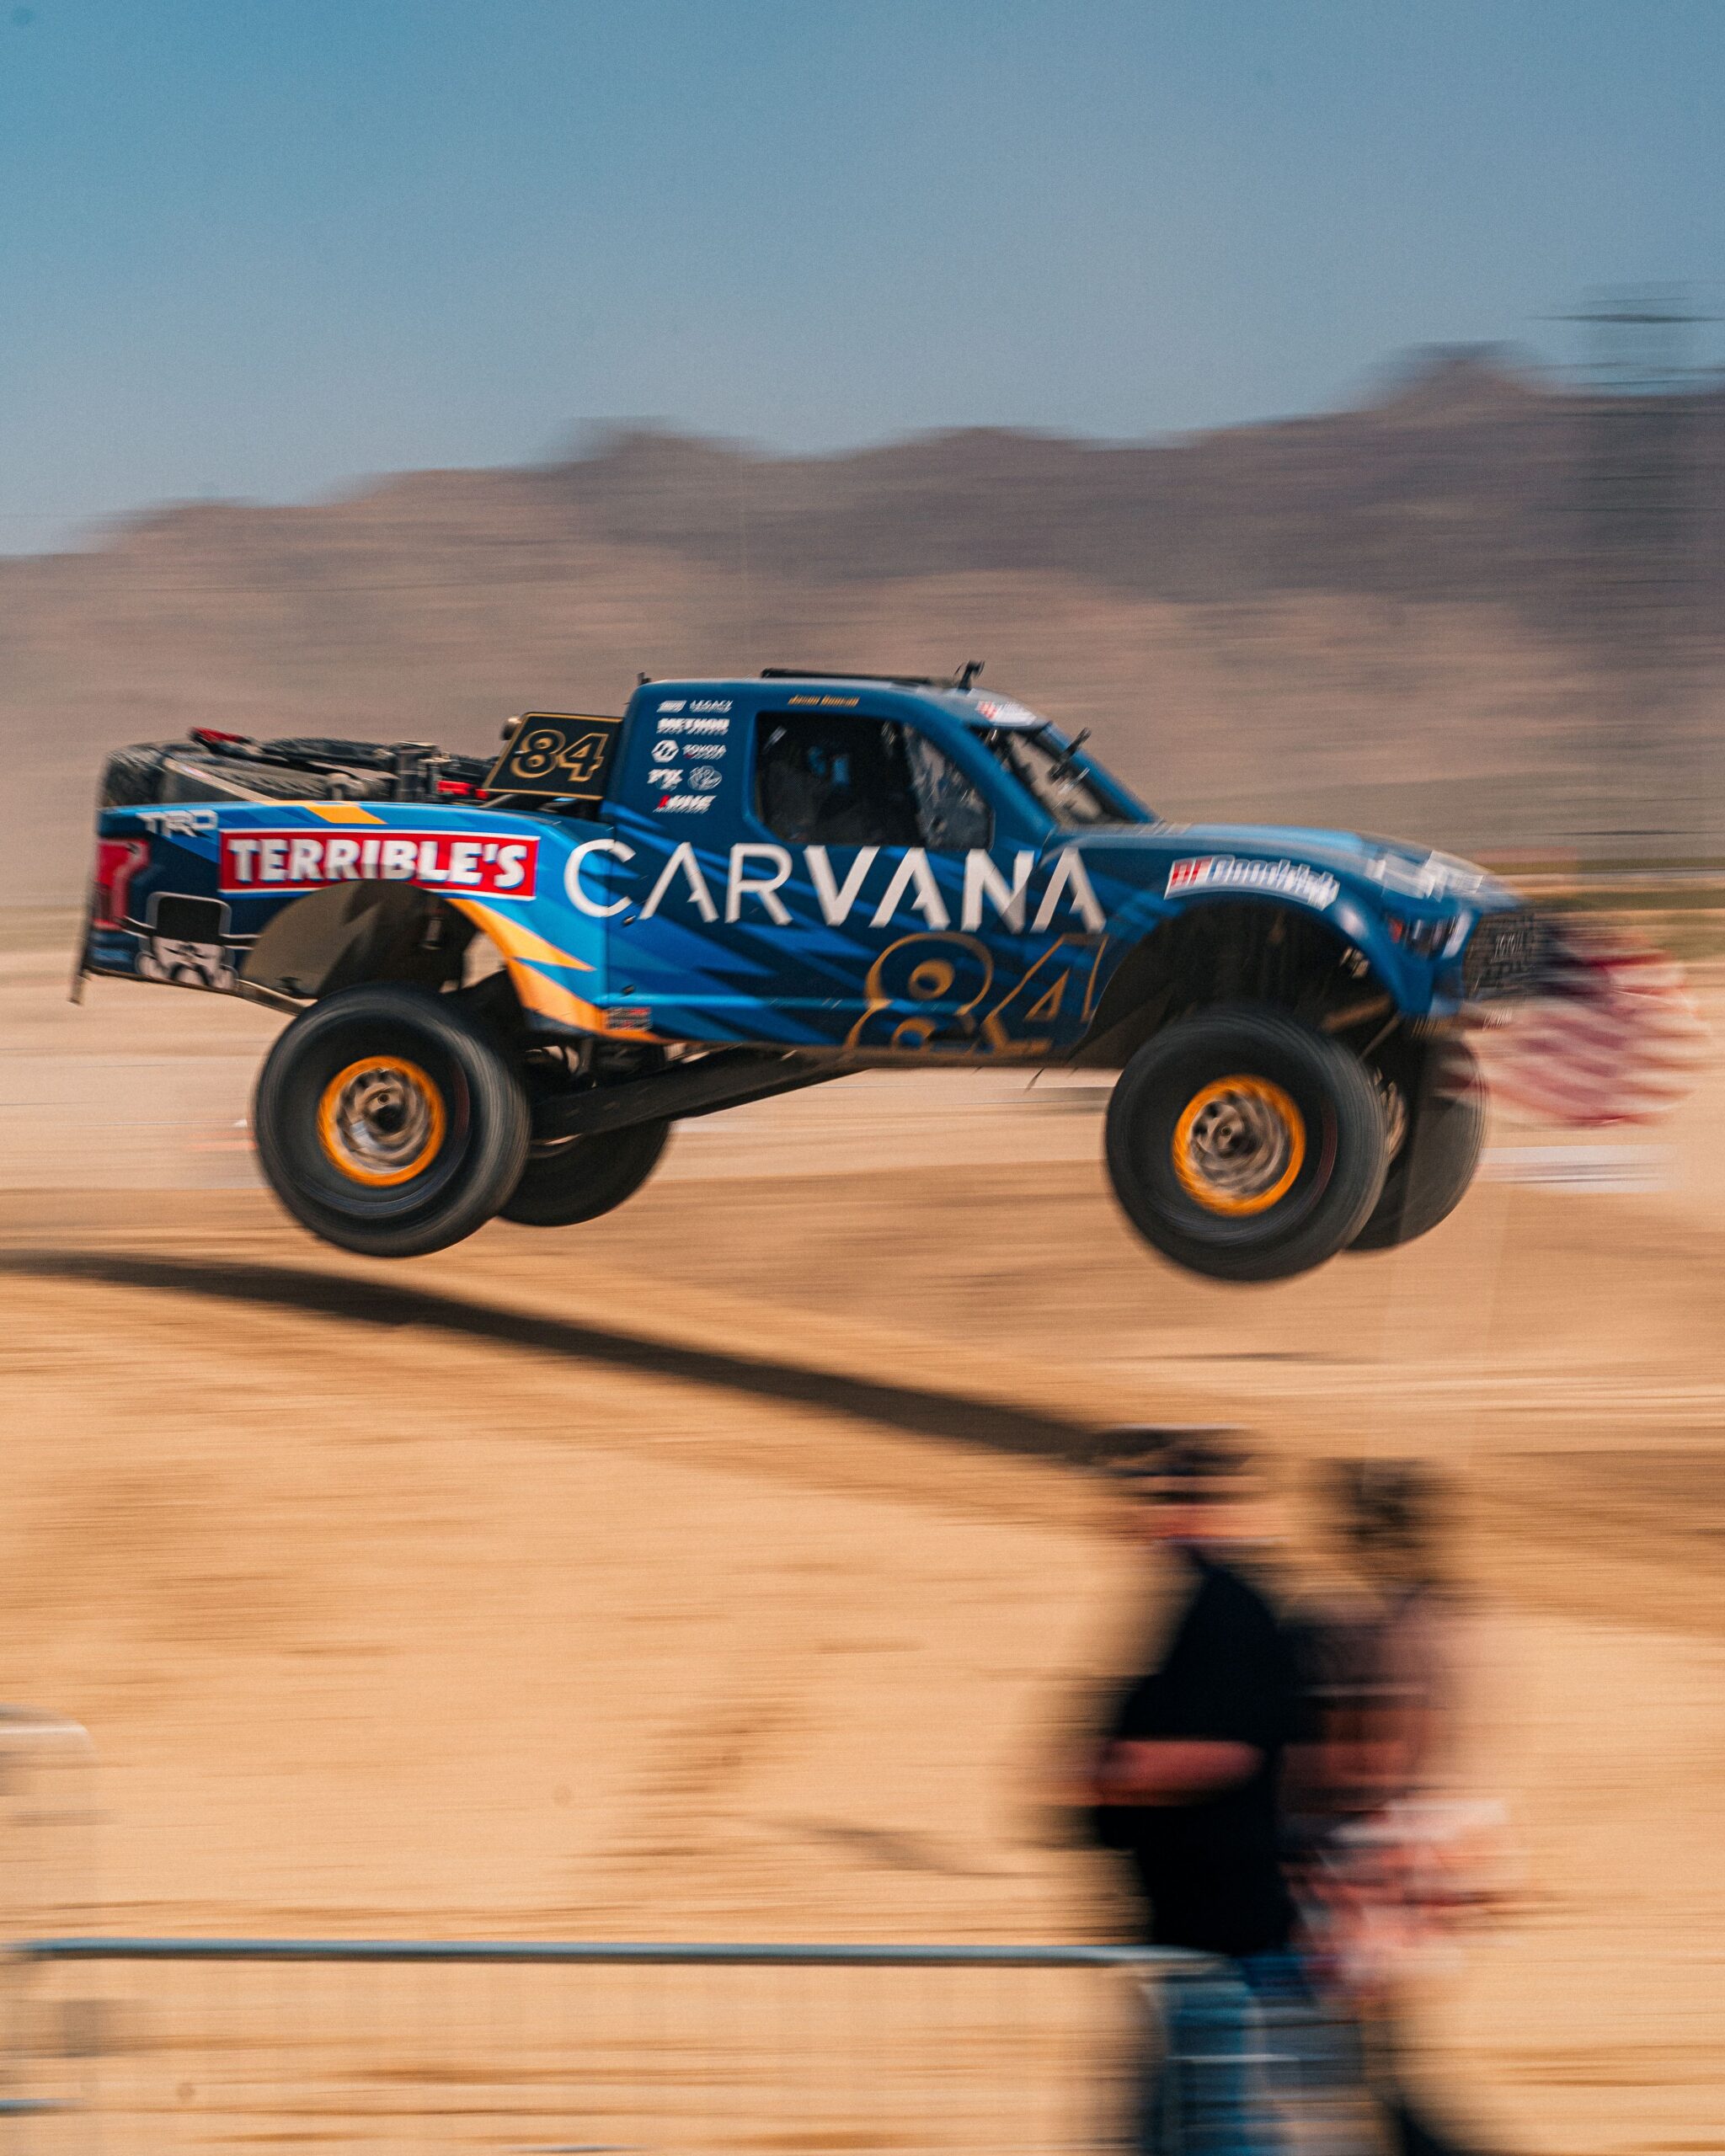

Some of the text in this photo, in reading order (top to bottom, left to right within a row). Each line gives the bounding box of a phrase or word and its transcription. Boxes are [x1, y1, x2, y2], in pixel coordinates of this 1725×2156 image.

[510, 727, 609, 782] 84
[136, 809, 218, 838] TRD
[227, 838, 526, 889] TERRIBLE'S
[563, 839, 1108, 934] CARVANA
[845, 931, 1108, 1054] 84
